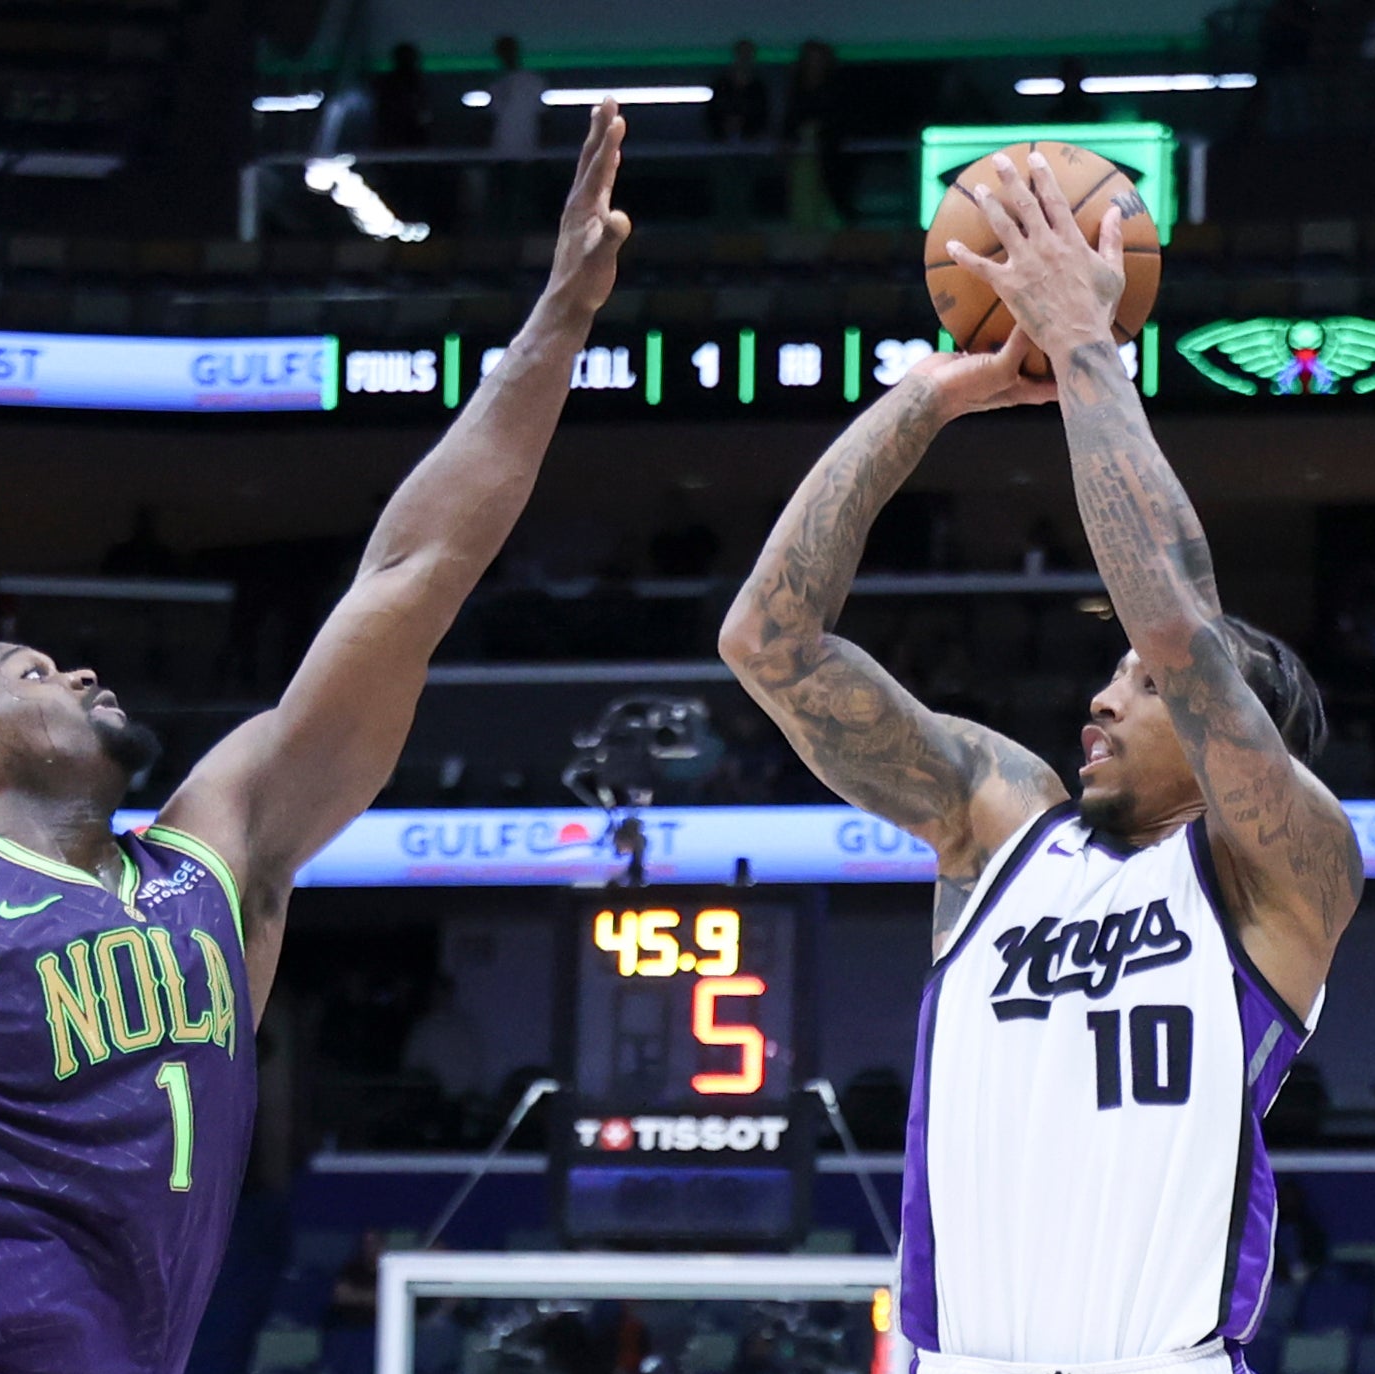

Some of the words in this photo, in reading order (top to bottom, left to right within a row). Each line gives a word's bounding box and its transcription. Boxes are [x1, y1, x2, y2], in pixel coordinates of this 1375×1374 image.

[691, 342, 720, 389] 1
[401, 820, 681, 858] GULFCOT
[594, 907, 740, 977] 45.9
[989, 897, 1192, 1002] Kngs
[36, 926, 237, 1082] NOLA
[691, 974, 767, 1095] 5
[1086, 1004, 1193, 1111] 10
[155, 1061, 194, 1192] 1
[631, 1115, 789, 1151] TISSOT
